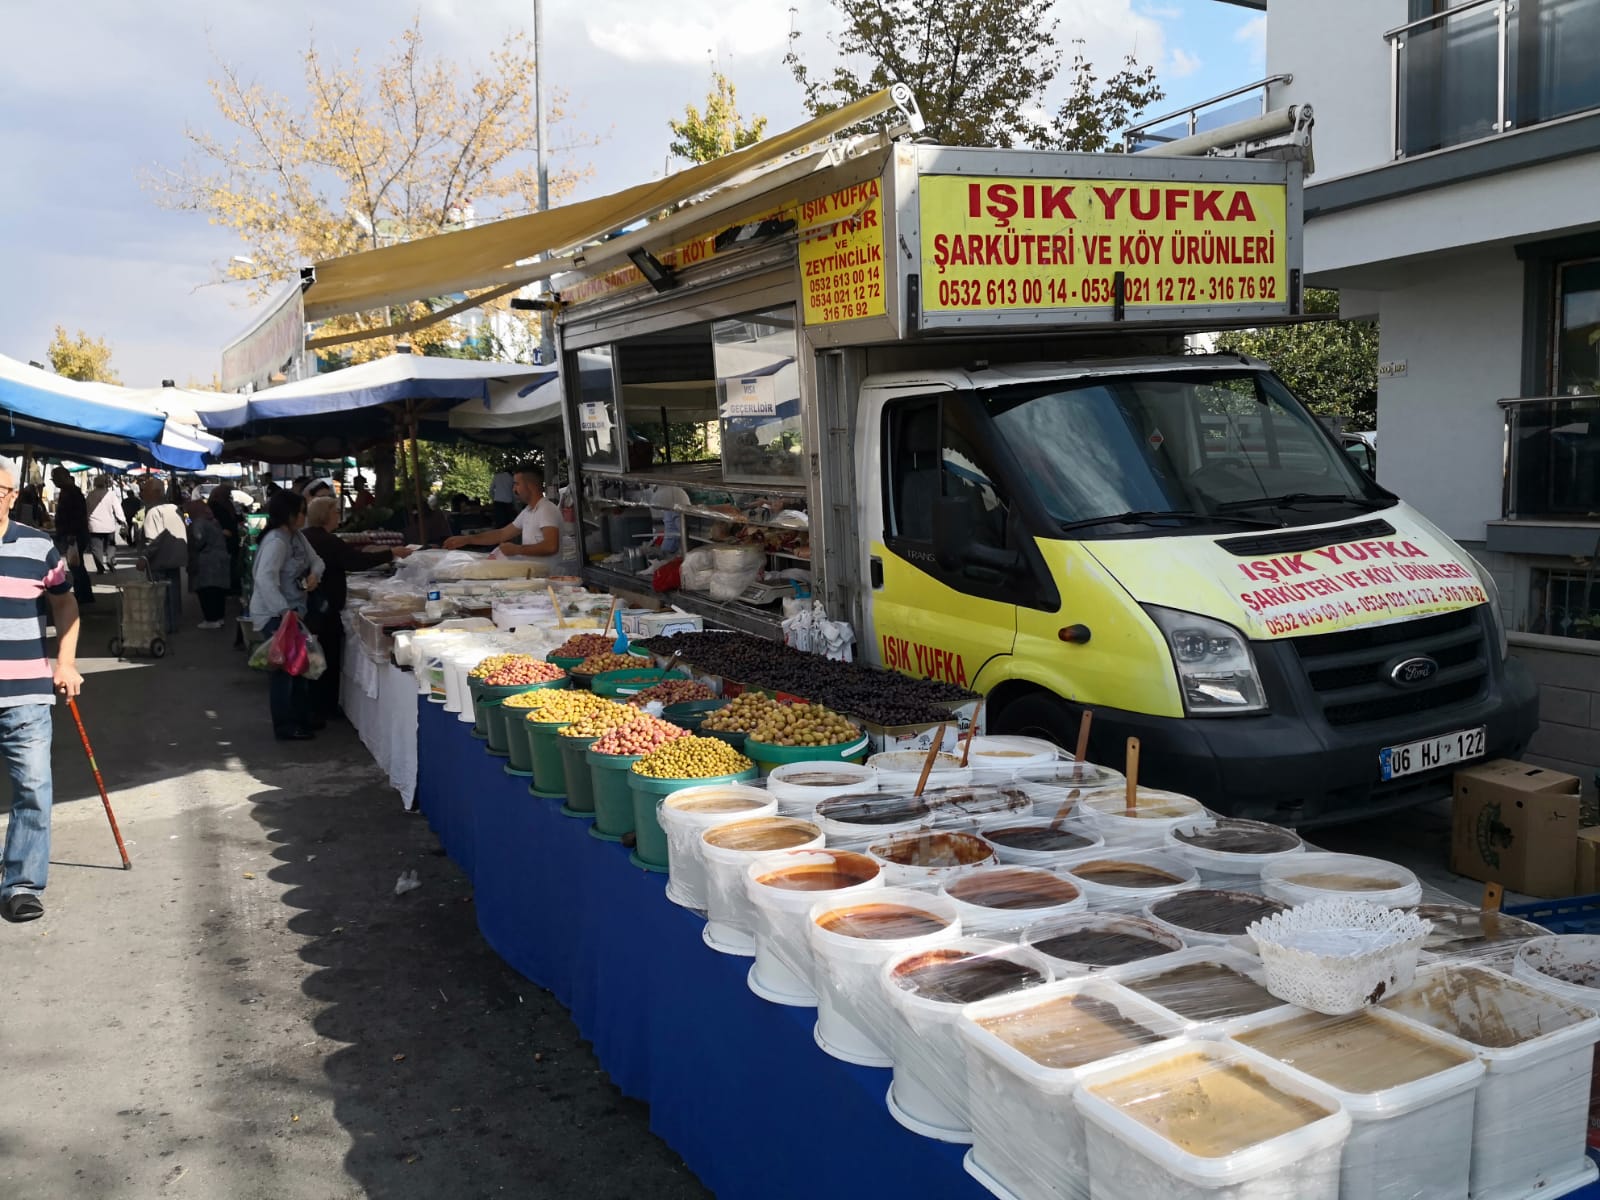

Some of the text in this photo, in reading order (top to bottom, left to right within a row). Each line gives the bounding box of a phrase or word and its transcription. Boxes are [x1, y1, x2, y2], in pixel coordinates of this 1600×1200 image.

[803, 179, 879, 223] IŞIK YUFKA
[969, 183, 1256, 227] IŞIK YUFKA
[805, 243, 881, 277] ZEYTİNCİLİK
[835, 239, 848, 249] VE
[934, 228, 1275, 274] ŞARKÜTERİ VE KÖY ÜRÜNLERİ
[810, 266, 879, 292] 0532 613 00 14
[810, 283, 880, 308] 0534 021 12 72
[939, 280, 982, 306] 0532
[986, 279, 1017, 305] 613
[1022, 279, 1043, 304] 00
[1048, 278, 1067, 303] 14
[1081, 278, 1116, 303] 0534
[1123, 278, 1152, 302] 021
[1157, 277, 1174, 301] 12
[1177, 277, 1196, 301] 72
[1209, 277, 1234, 300] 316
[1239, 276, 1256, 299] 76
[1259, 275, 1275, 299] 92
[823, 301, 868, 321] 316 76 92
[1238, 540, 1429, 584] IŞIK YUFKA
[1240, 560, 1473, 615] ŞARKÜTERİ VE KÖY ÜRÜNLERİ
[1265, 612, 1300, 636] 0532
[1298, 607, 1323, 627] 613
[1340, 601, 1356, 617] 14
[1358, 594, 1390, 612] 0534
[1385, 591, 1409, 608] 021
[1407, 589, 1425, 605] 12
[1420, 588, 1438, 603] 72
[1440, 586, 1460, 602] 316
[1458, 586, 1474, 602] 76
[1470, 585, 1486, 602] 92
[883, 634, 968, 688] IŞIK YUFKA
[1405, 664, 1430, 680] Ford
[1392, 748, 1410, 774] 06
[1421, 741, 1440, 767] HJ
[1457, 731, 1483, 757] 122
